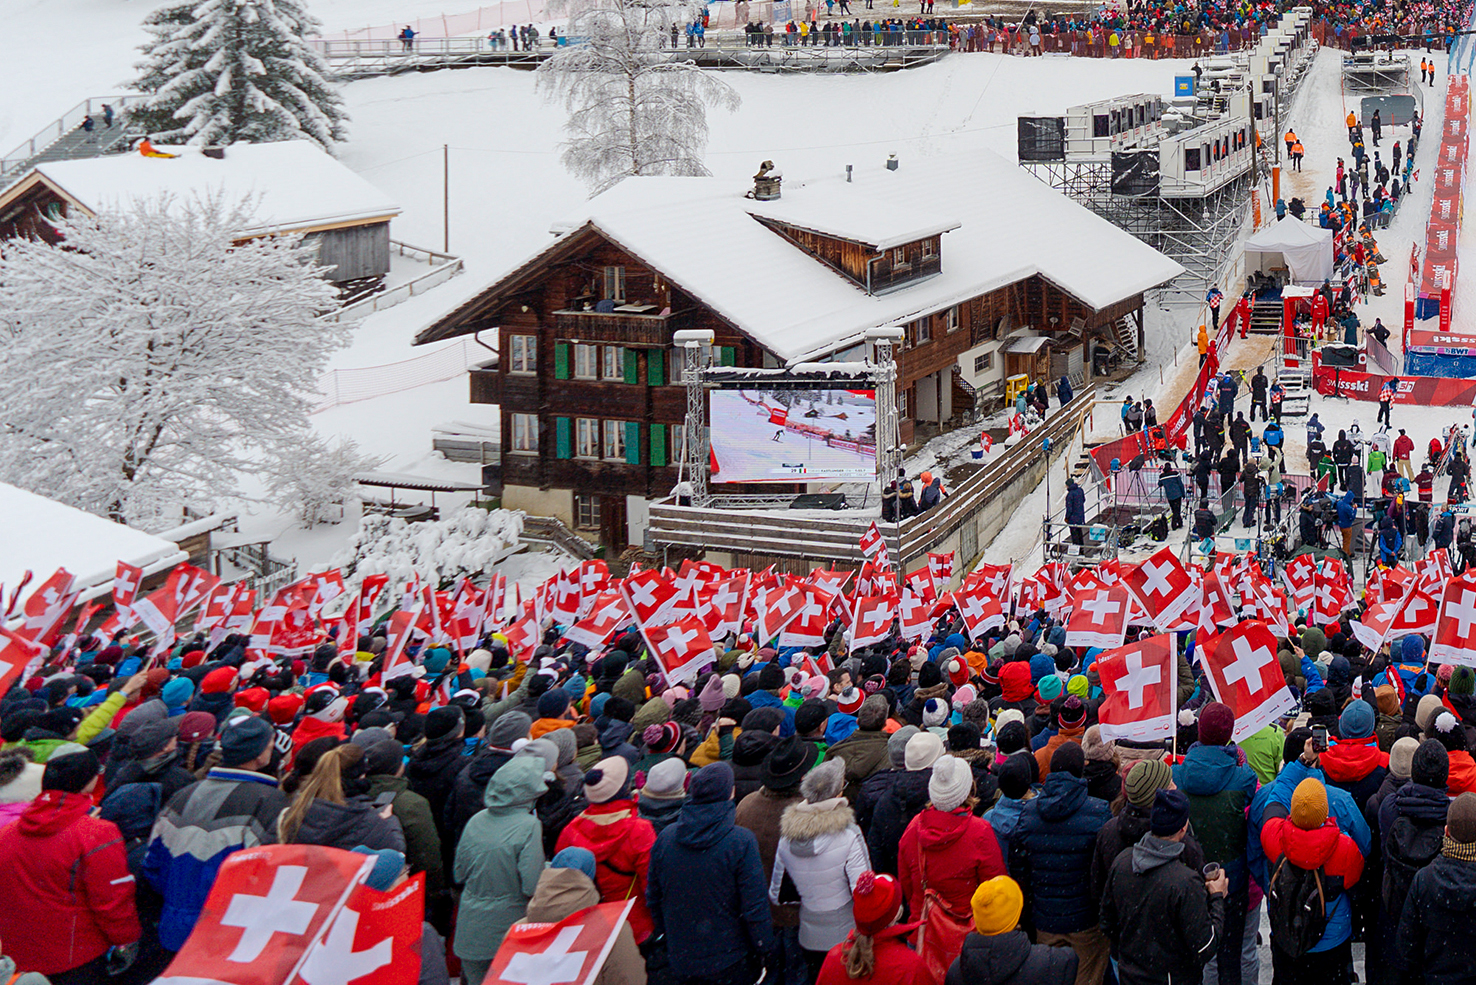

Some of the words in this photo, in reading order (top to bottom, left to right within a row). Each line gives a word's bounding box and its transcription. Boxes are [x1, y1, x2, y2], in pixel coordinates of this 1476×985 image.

[1439, 199, 1452, 220] swissski
[1436, 229, 1449, 251] swissski
[1430, 264, 1446, 288] swissski
